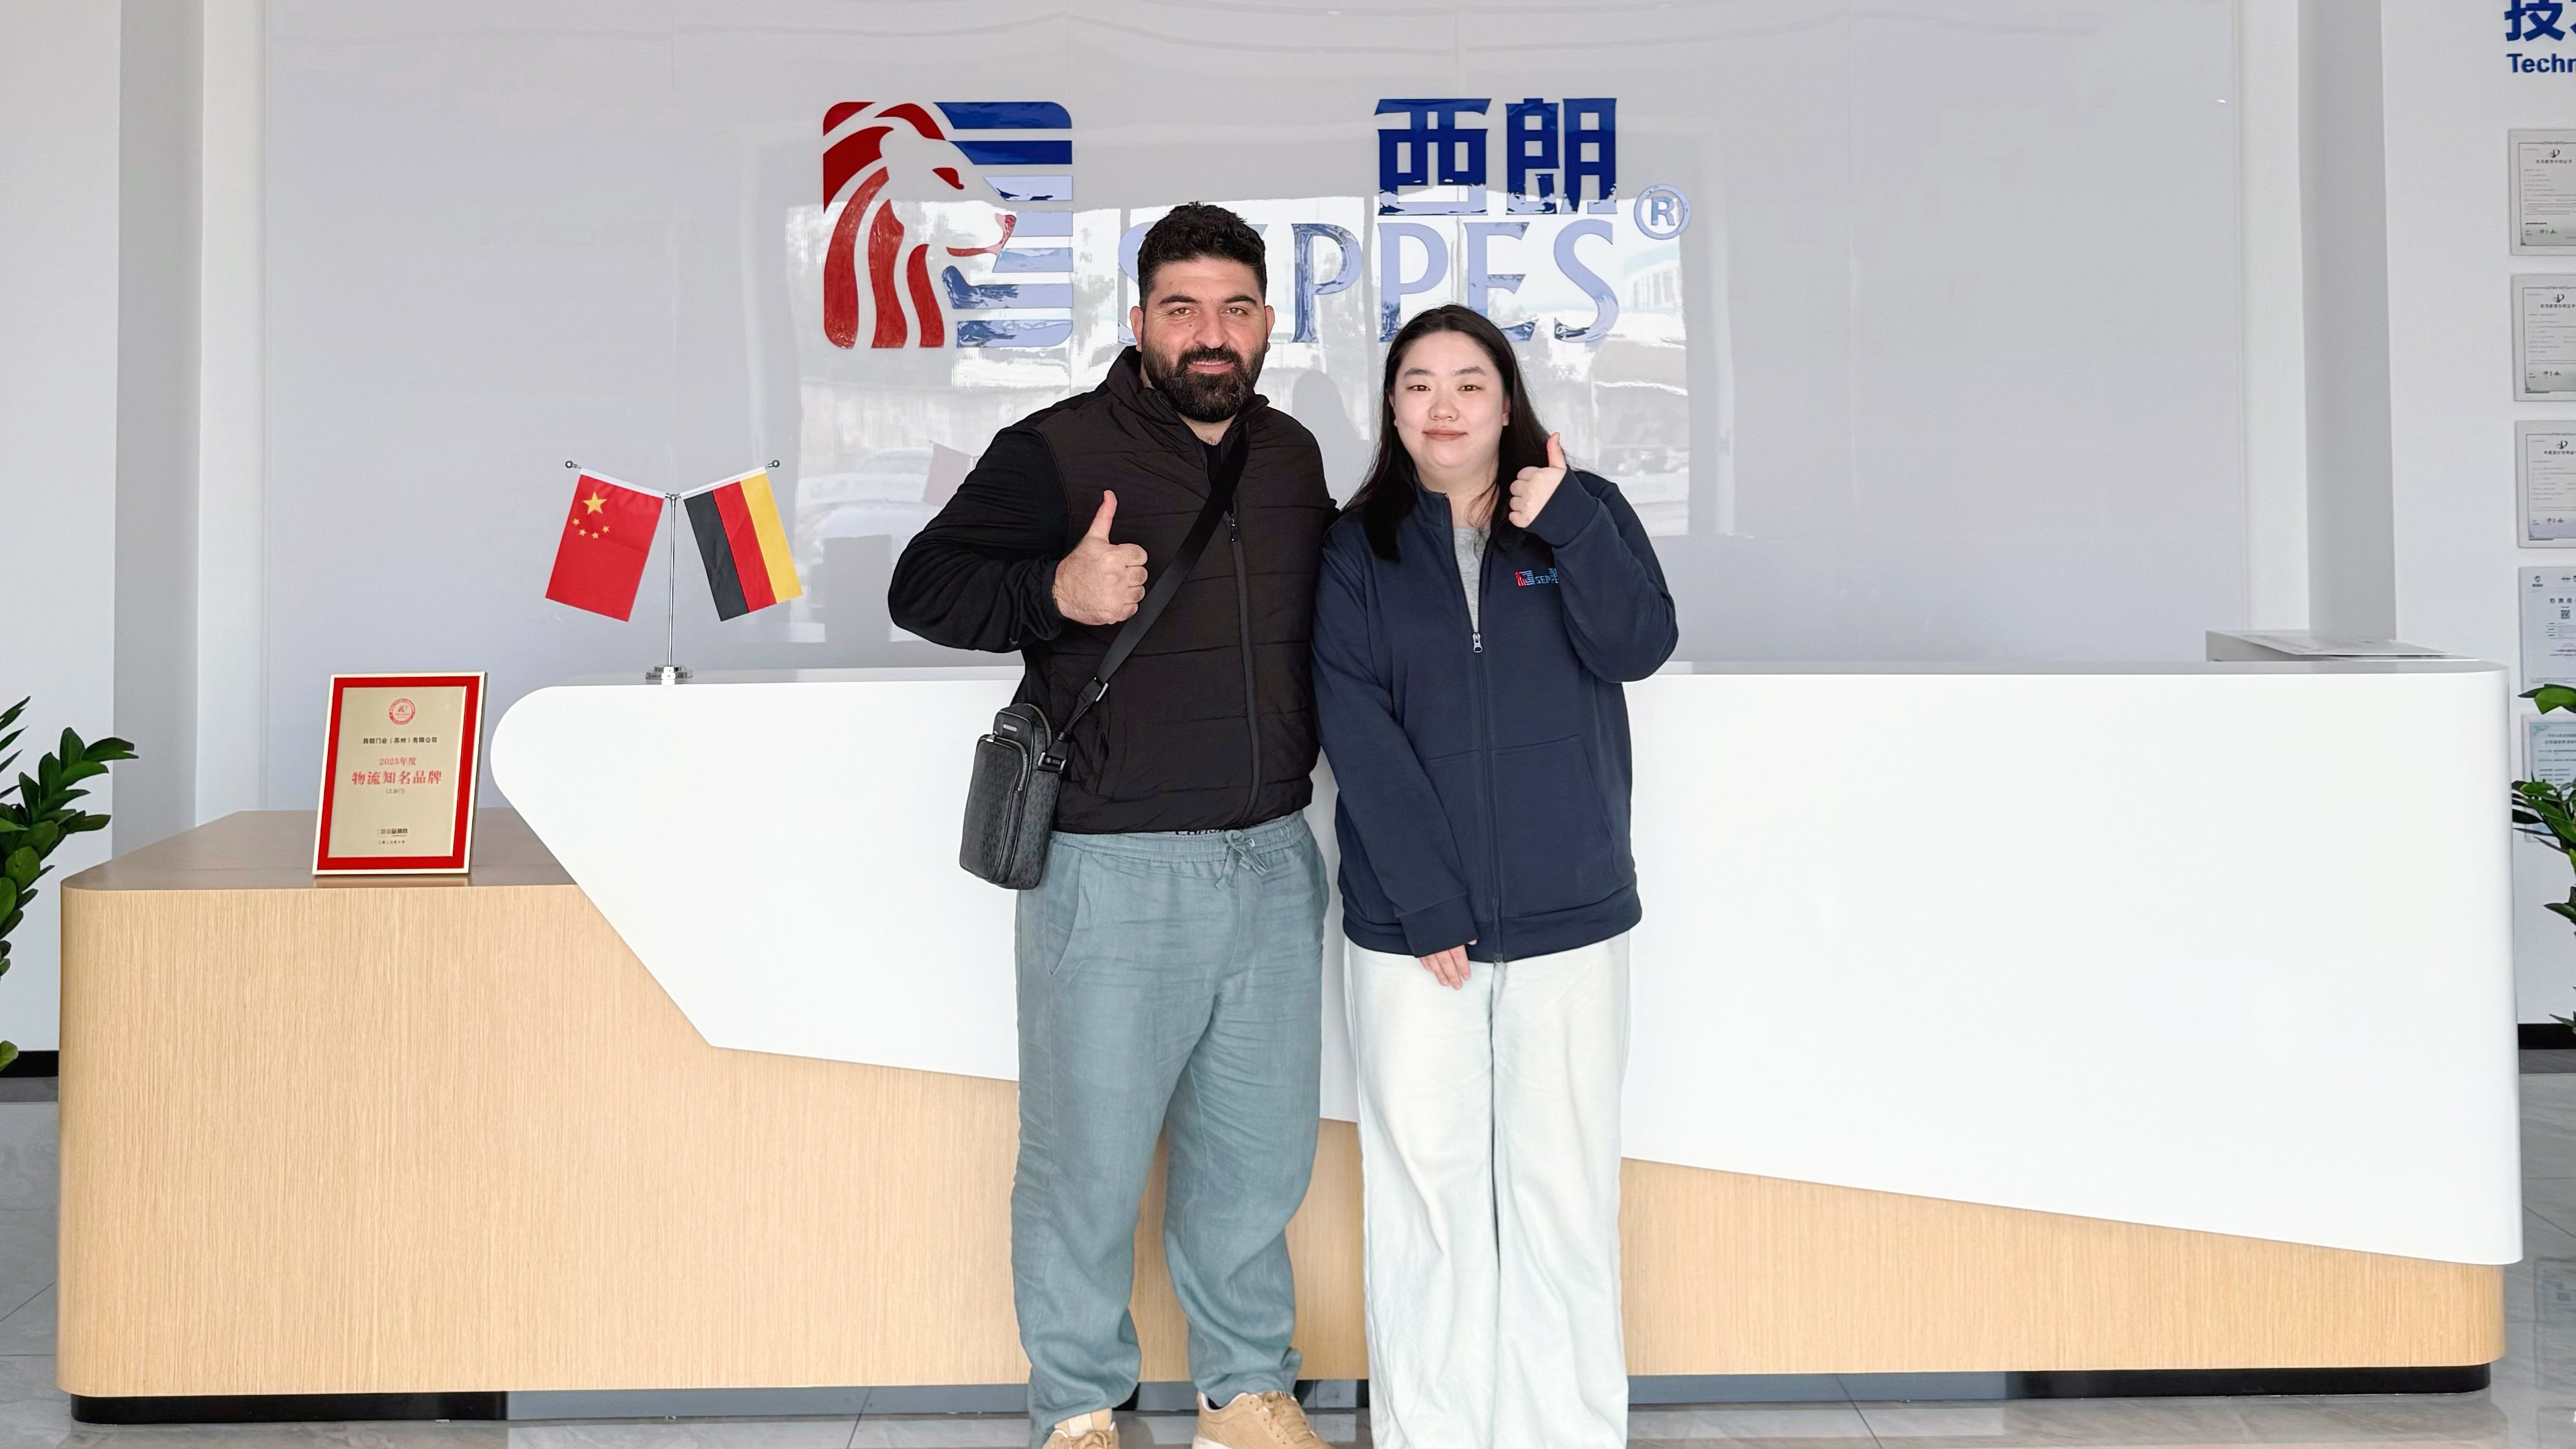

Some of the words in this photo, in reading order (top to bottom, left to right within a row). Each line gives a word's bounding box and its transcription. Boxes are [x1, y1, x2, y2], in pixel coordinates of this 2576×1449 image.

[2504, 0, 2576, 41] 技
[1374, 97, 1618, 216] 西朗
[1117, 218, 1620, 343] PPES
[351, 770, 443, 785] 物流知名品牌
